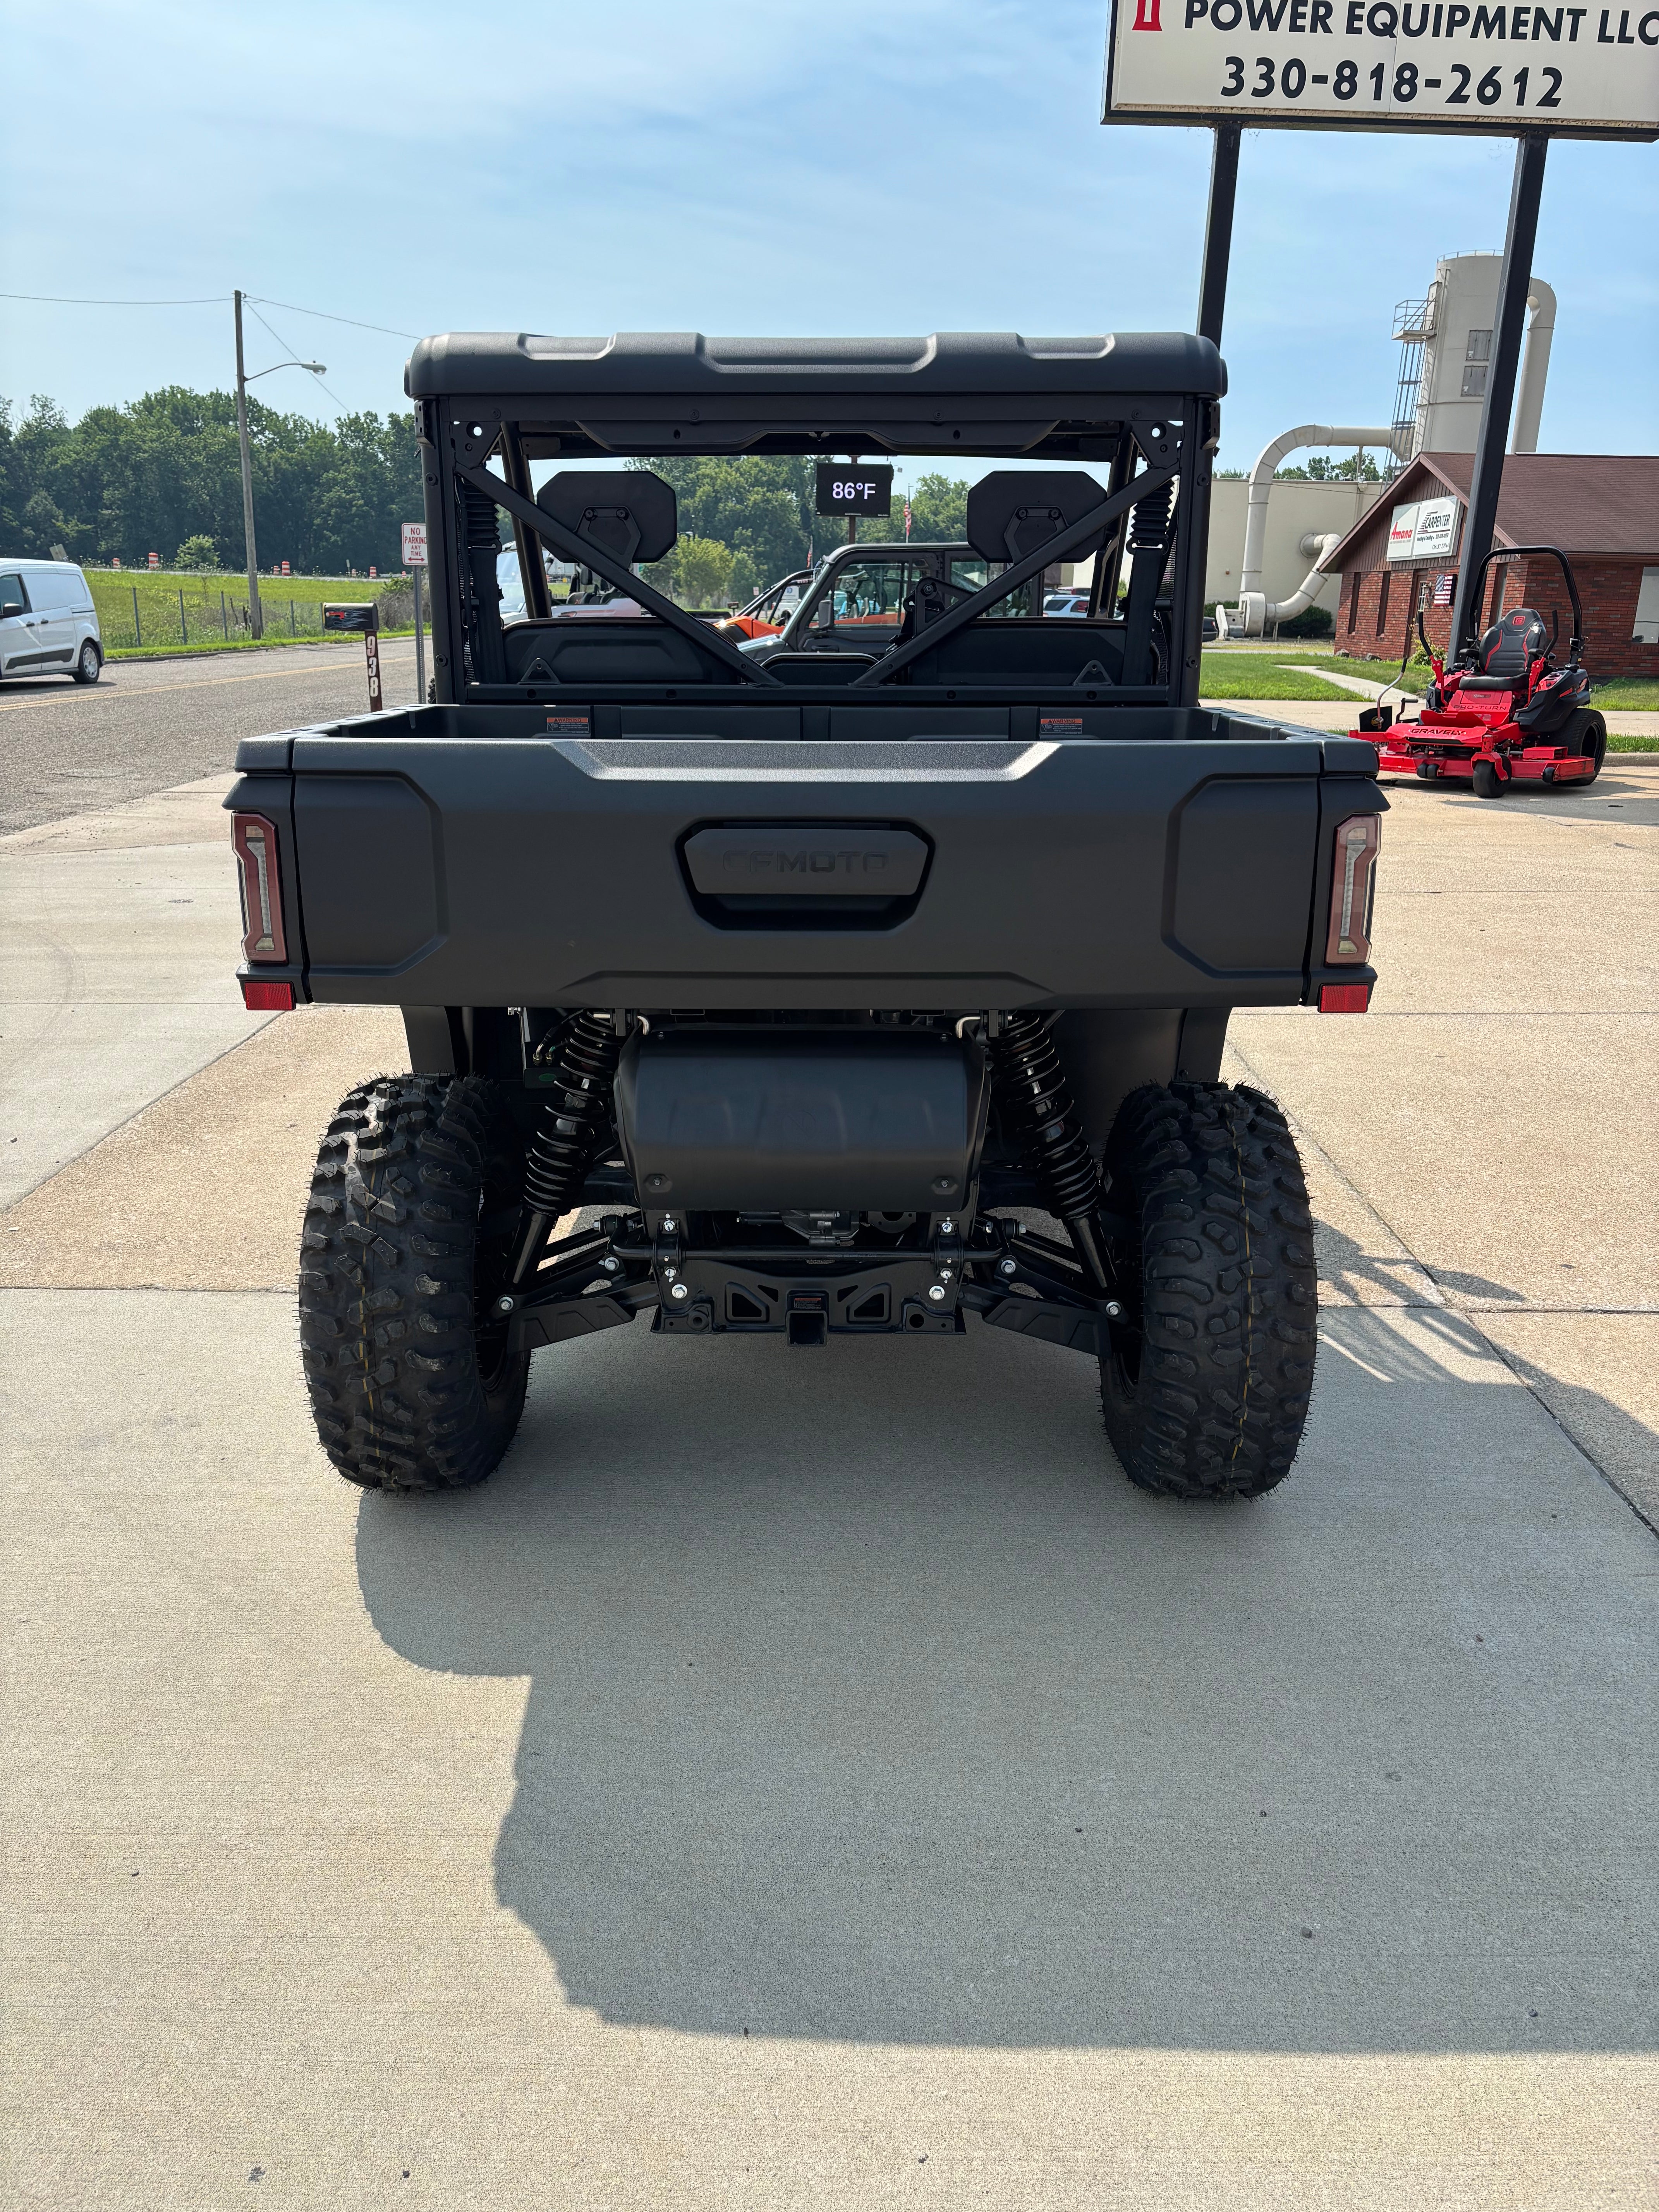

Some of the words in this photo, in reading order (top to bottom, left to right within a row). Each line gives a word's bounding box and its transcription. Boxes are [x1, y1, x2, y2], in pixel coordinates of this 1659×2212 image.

[1185, 0, 1333, 34] POWER
[1346, 1, 1587, 42] EQUIPMENT
[1597, 9, 1659, 45] LLC
[1220, 56, 1563, 107] 330-818-2612
[832, 482, 876, 500] 86°F
[1390, 521, 1413, 540] Amana
[1425, 514, 1450, 529] CARPENTER
[367, 636, 378, 697] 938
[723, 850, 889, 873] CFMOTO
